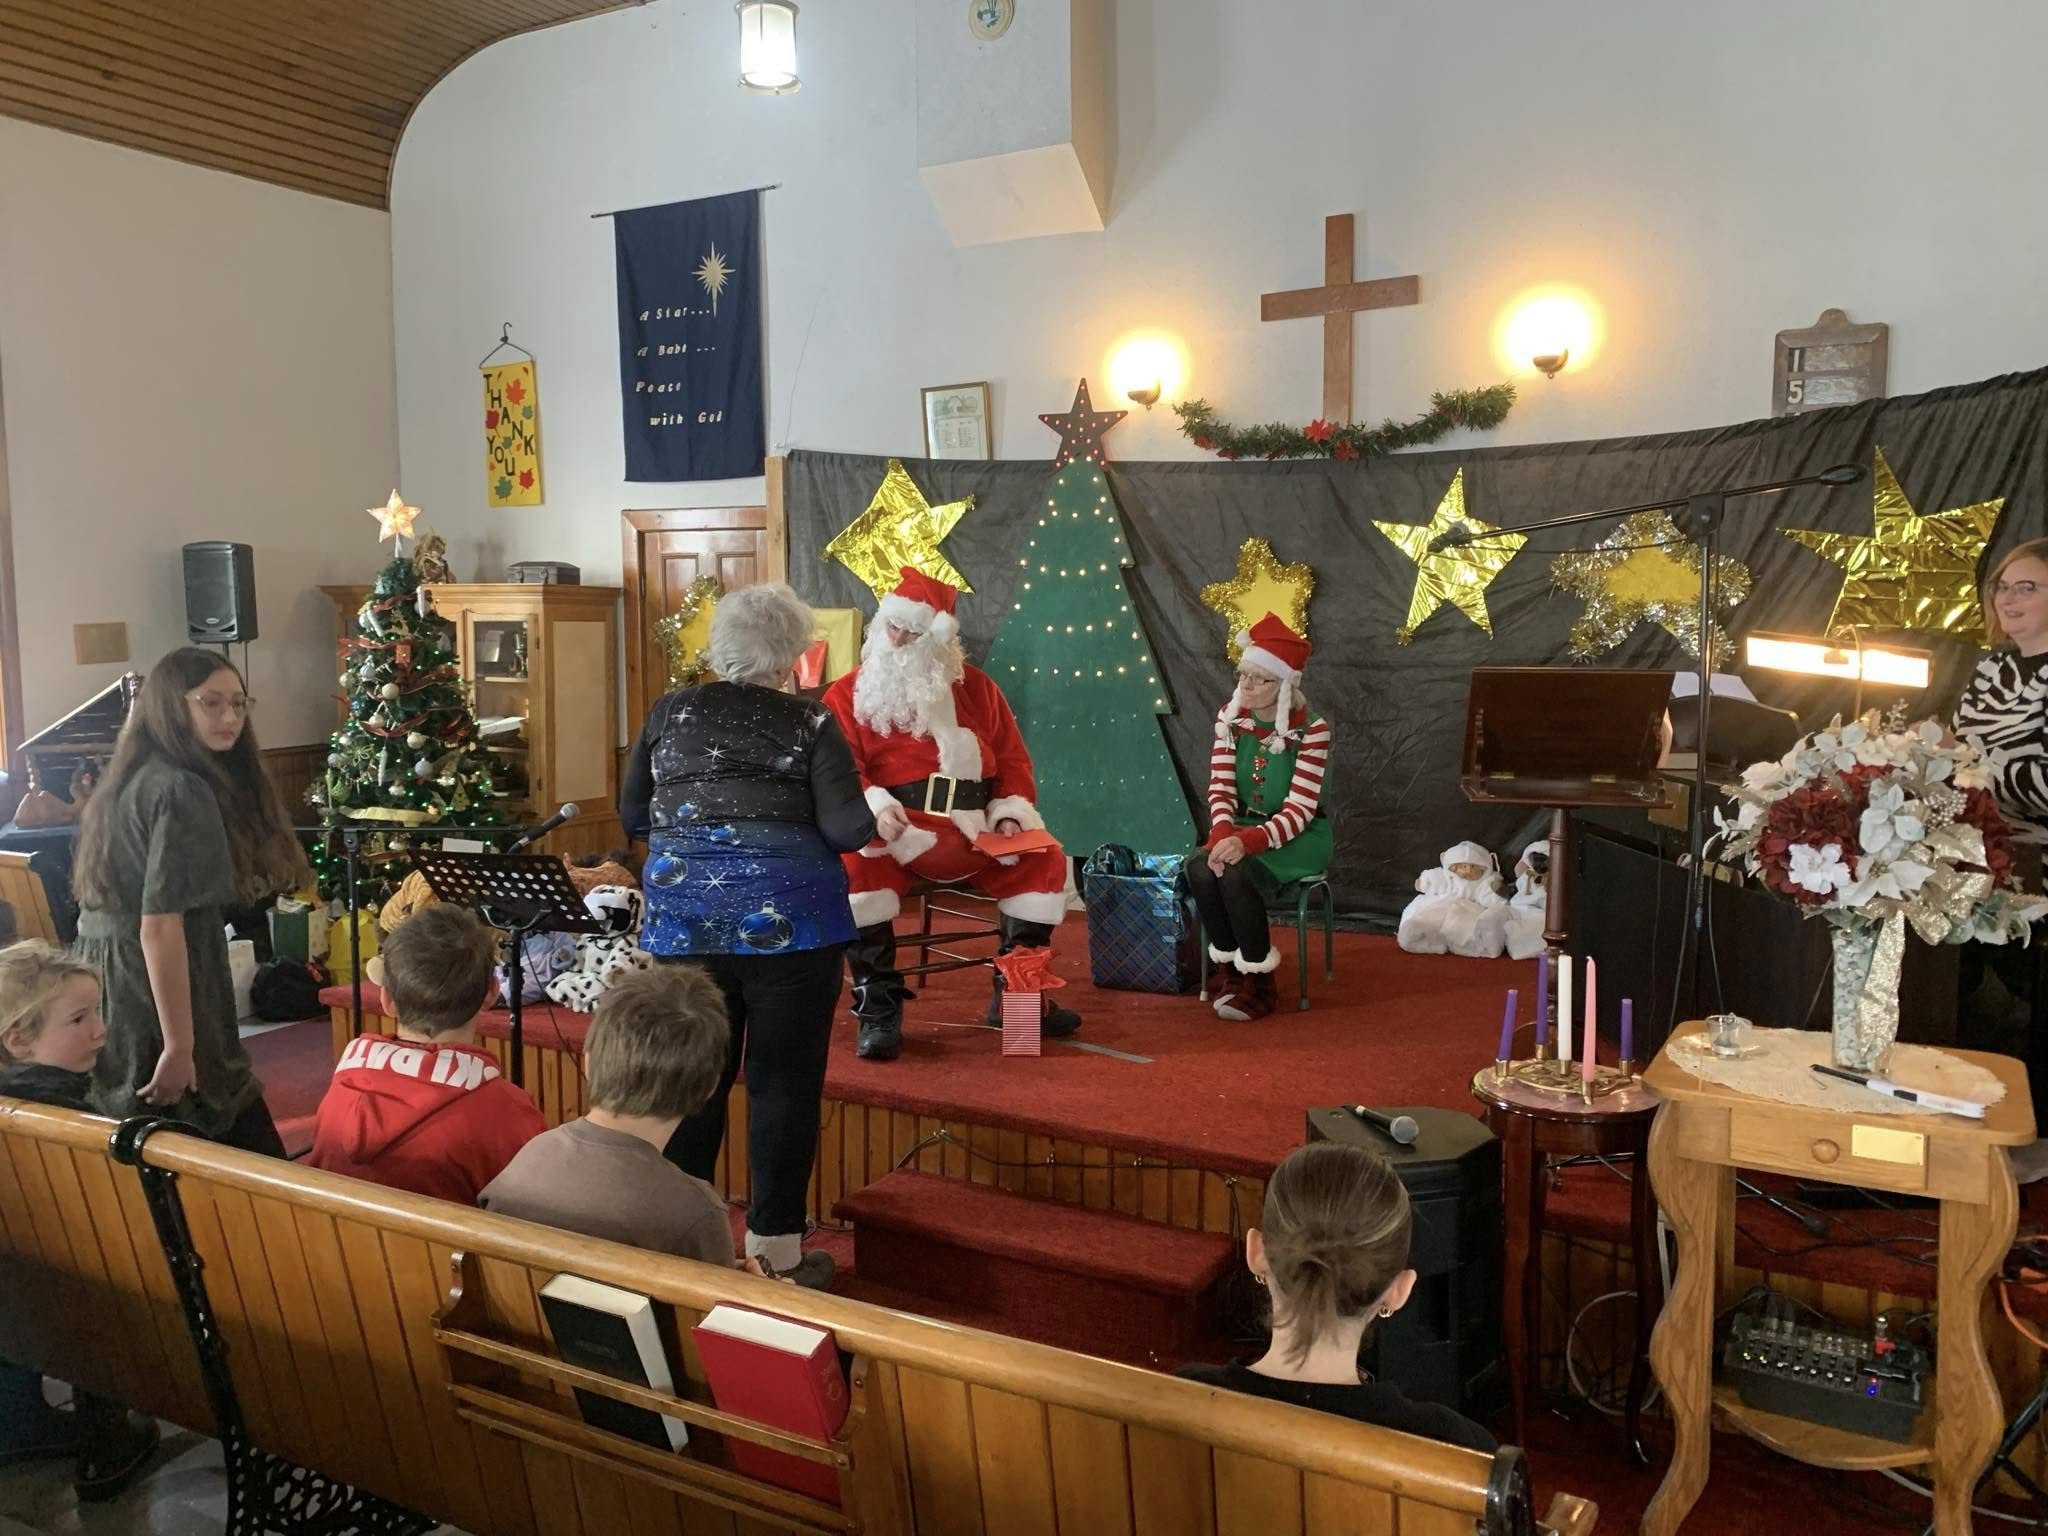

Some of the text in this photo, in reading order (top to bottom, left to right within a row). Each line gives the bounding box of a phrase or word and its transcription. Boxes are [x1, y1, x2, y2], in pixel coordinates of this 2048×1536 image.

[639, 310, 649, 321] A
[637, 346, 649, 357] A
[657, 343, 687, 356] Babe
[635, 380, 682, 393] Peace
[1787, 380, 1803, 404] 5
[483, 373, 535, 456] THANK
[649, 410, 722, 426] with God
[486, 435, 516, 477] YOU
